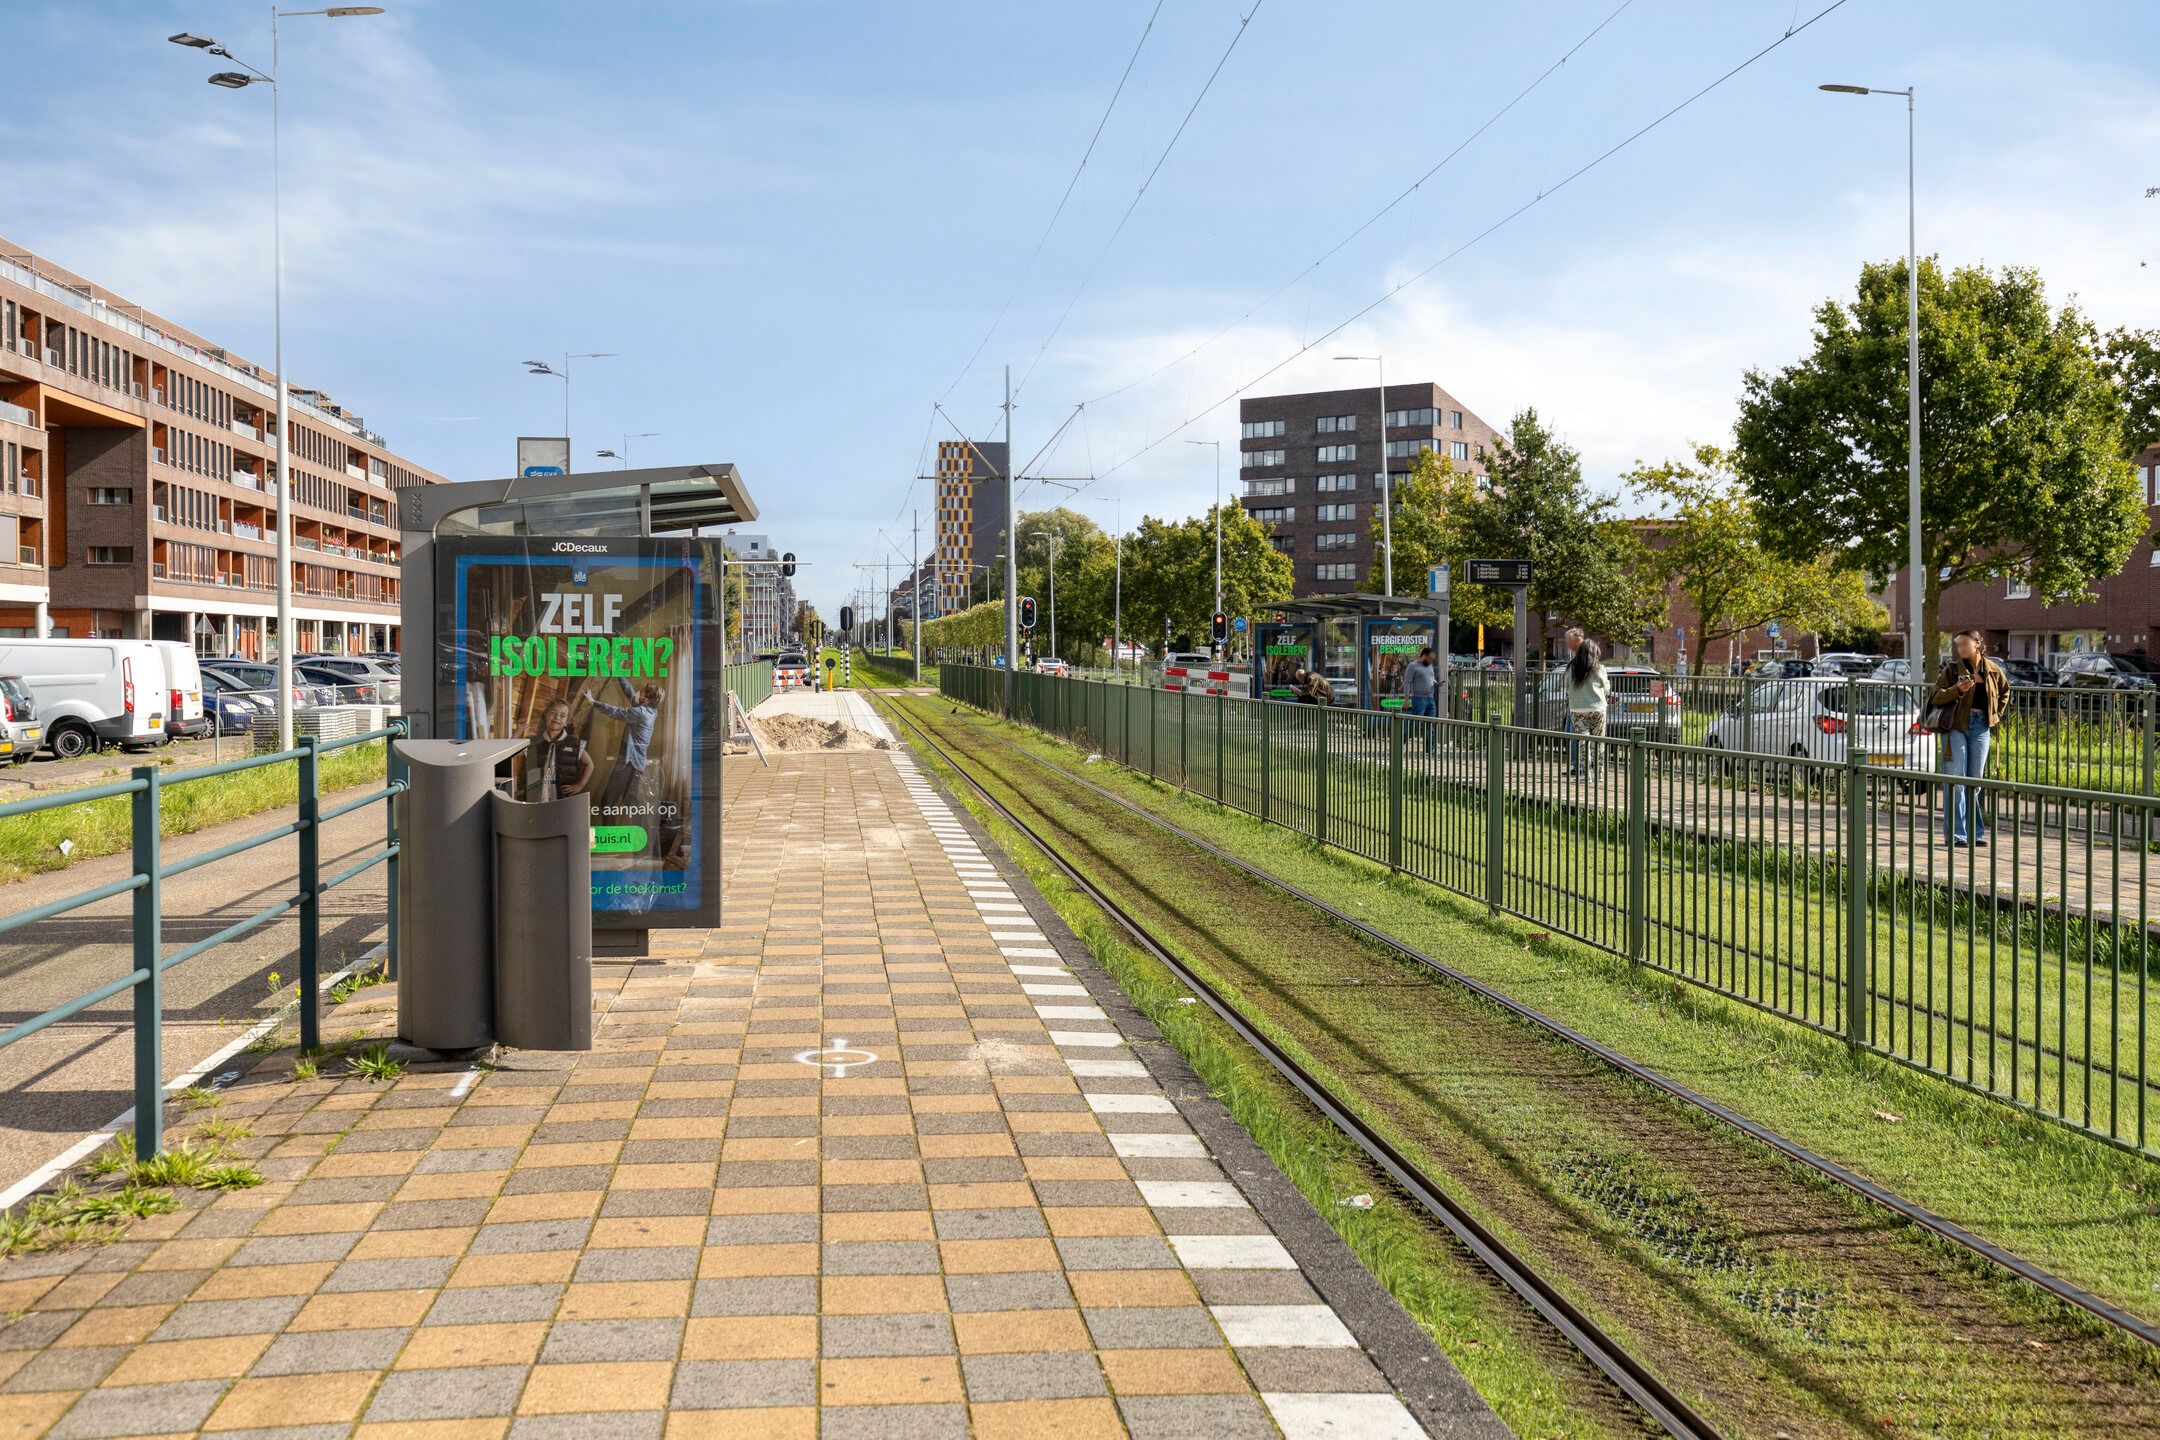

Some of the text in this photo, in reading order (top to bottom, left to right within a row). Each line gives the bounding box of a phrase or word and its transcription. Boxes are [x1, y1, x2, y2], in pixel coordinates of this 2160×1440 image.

[551, 542, 608, 553] JCDecaux
[540, 593, 623, 634] ZELF
[1277, 635, 1297, 646] ZELF
[1371, 635, 1428, 645] ENERGIEKOSTEN
[490, 635, 674, 678] ISOLEREN?
[1265, 645, 1308, 656] ISOLEREN?
[602, 802, 655, 819] aanpak
[657, 804, 678, 818] op
[605, 884, 621, 895] de
[624, 882, 688, 895] toekomst?
